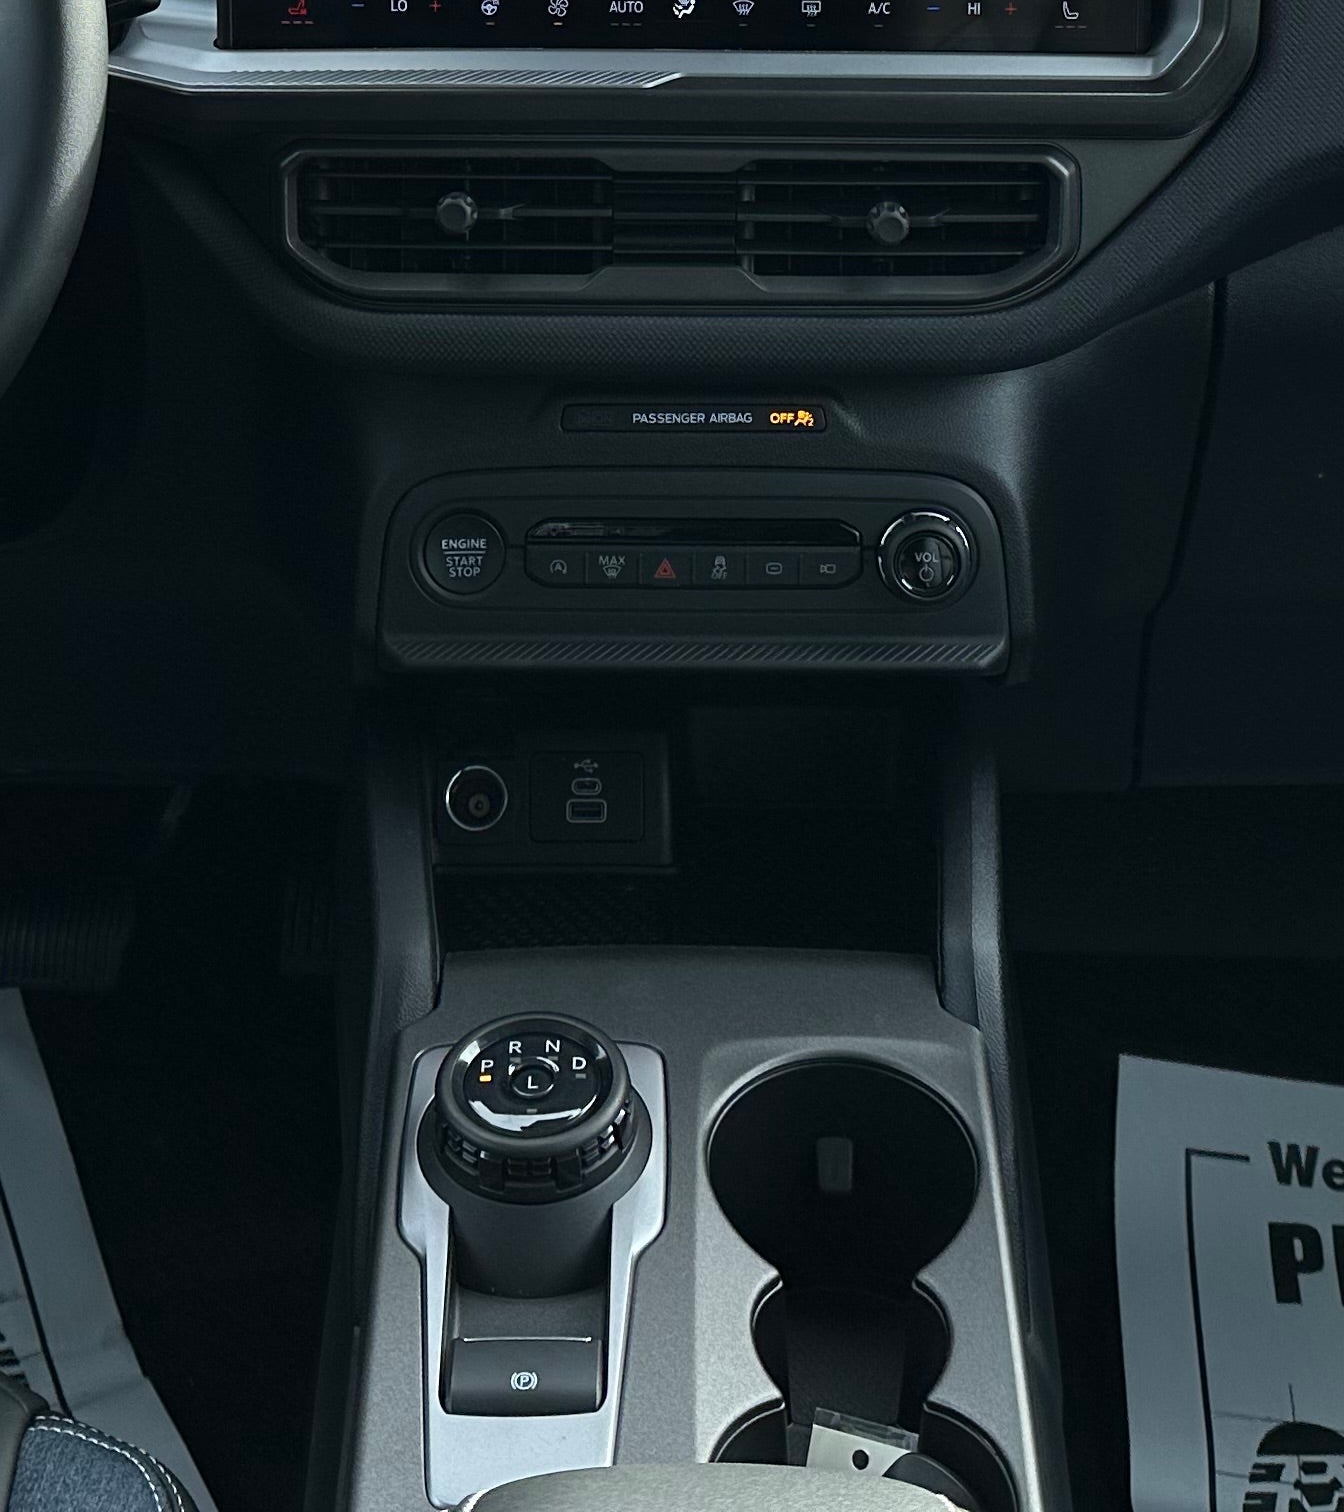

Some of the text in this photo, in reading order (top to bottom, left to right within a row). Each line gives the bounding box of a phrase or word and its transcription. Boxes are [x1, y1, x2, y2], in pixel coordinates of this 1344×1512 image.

[608, 0, 644, 14] AUTO
[868, 2, 891, 16] A/C
[967, 3, 981, 16] HI
[632, 412, 705, 425] PASSENGER
[709, 412, 753, 425] AIRBAG
[769, 412, 795, 425] OFF
[441, 537, 488, 550] ENGINE
[445, 556, 483, 567] START
[598, 555, 626, 566] MAX
[914, 552, 940, 563] VOL
[448, 567, 481, 579] STOP
[508, 1041, 522, 1054] R
[545, 1040, 561, 1053] N
[481, 1059, 494, 1073] P
[572, 1057, 587, 1070] D
[527, 1076, 539, 1089] L
